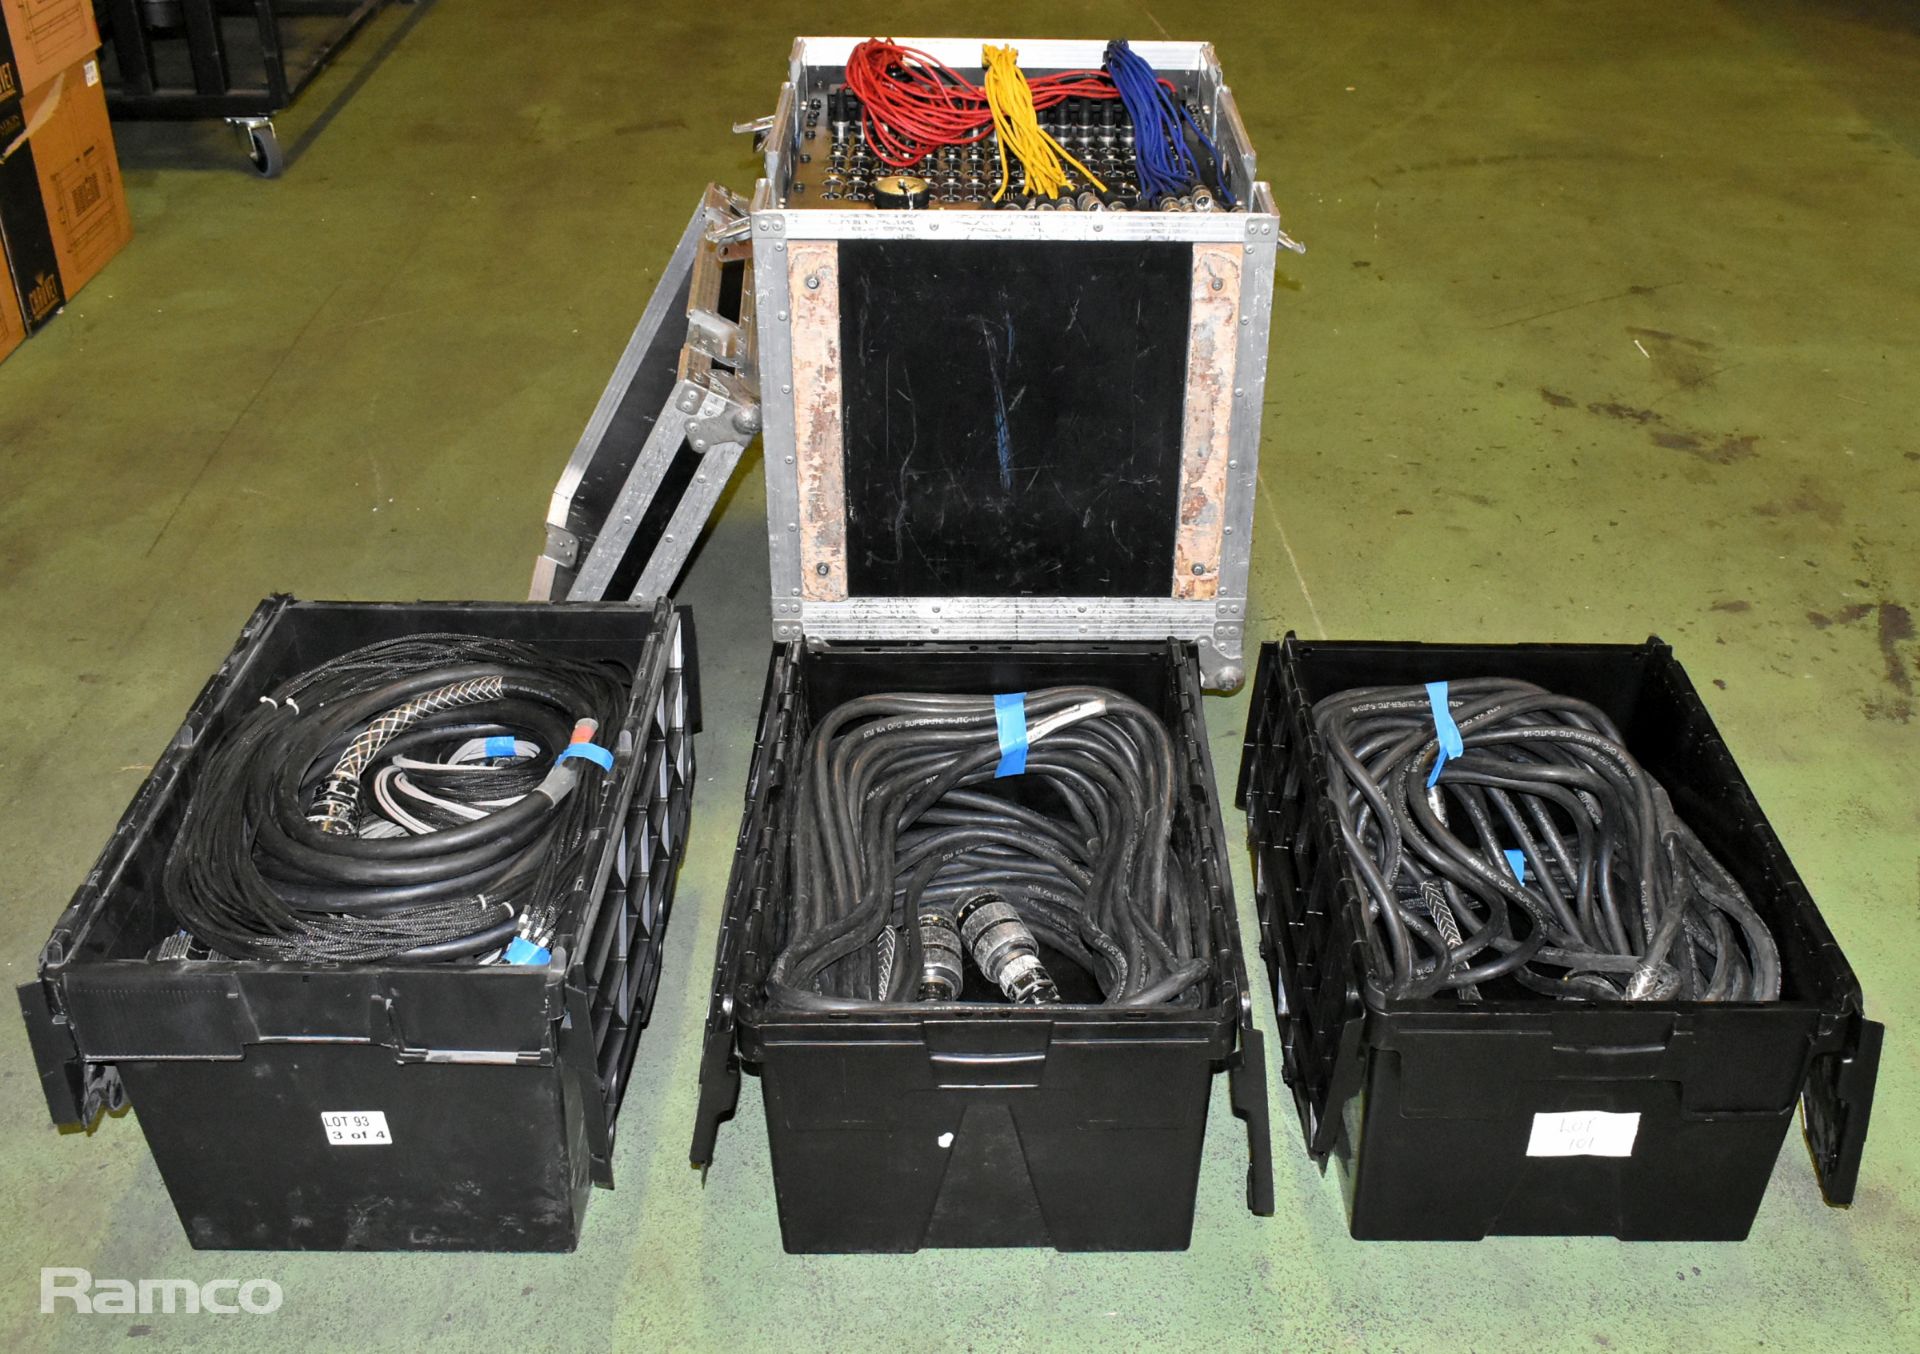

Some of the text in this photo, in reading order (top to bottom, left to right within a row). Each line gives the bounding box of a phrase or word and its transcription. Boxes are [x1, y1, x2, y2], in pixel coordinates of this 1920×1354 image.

[324, 1116, 369, 1127] LOT 93
[332, 1130, 386, 1139] 3 of 4
